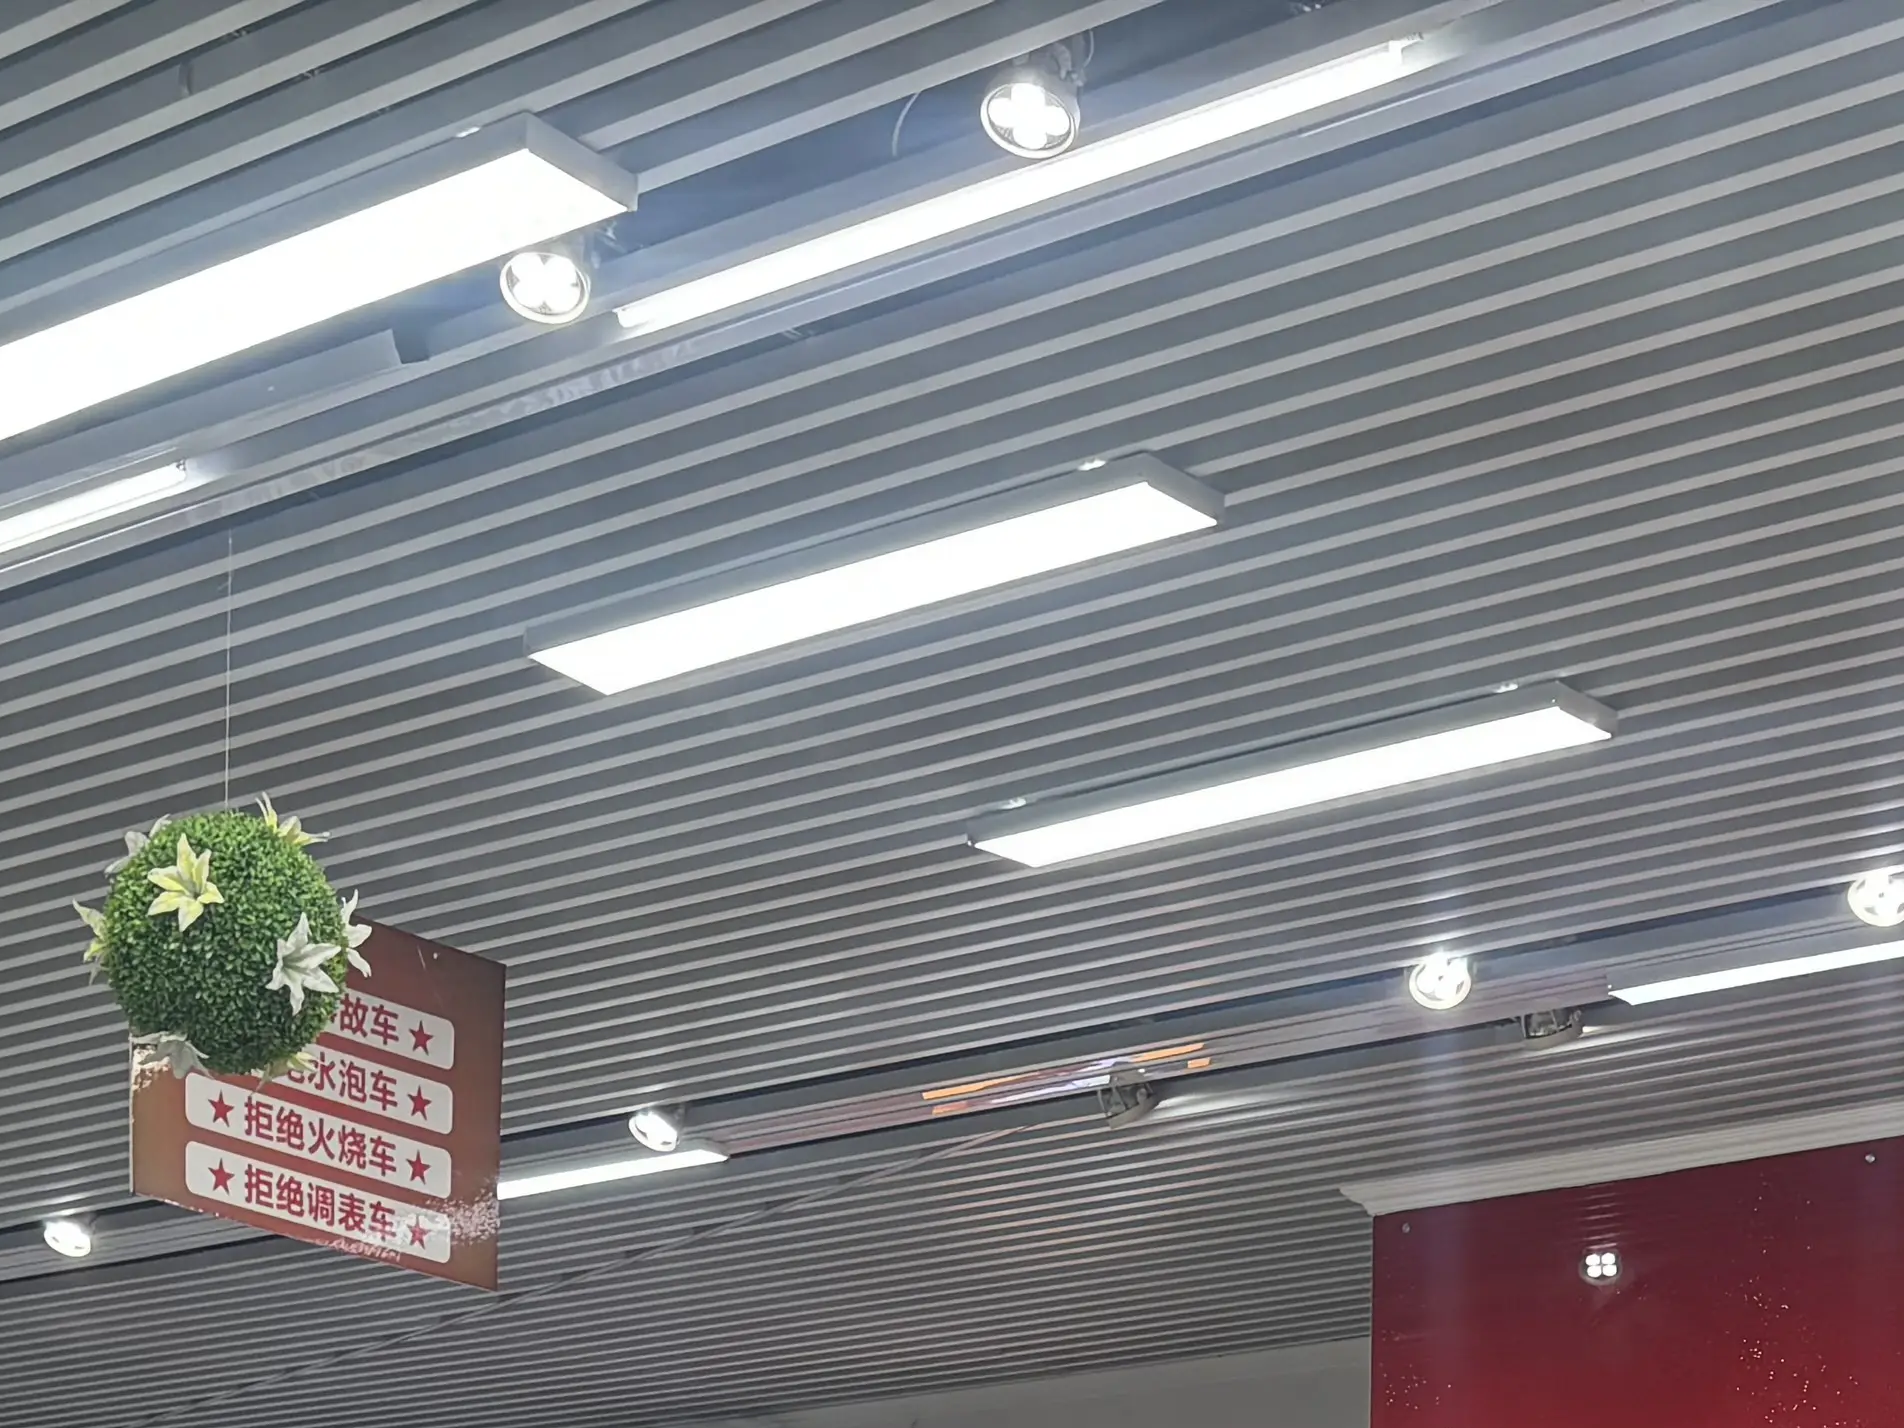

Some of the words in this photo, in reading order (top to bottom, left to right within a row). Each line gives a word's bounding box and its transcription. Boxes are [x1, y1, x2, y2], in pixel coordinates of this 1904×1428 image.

[331, 994, 399, 1045] 故车
[243, 1096, 398, 1177] 拒绝火烧车
[244, 1163, 397, 1242] 拒绝调表车
